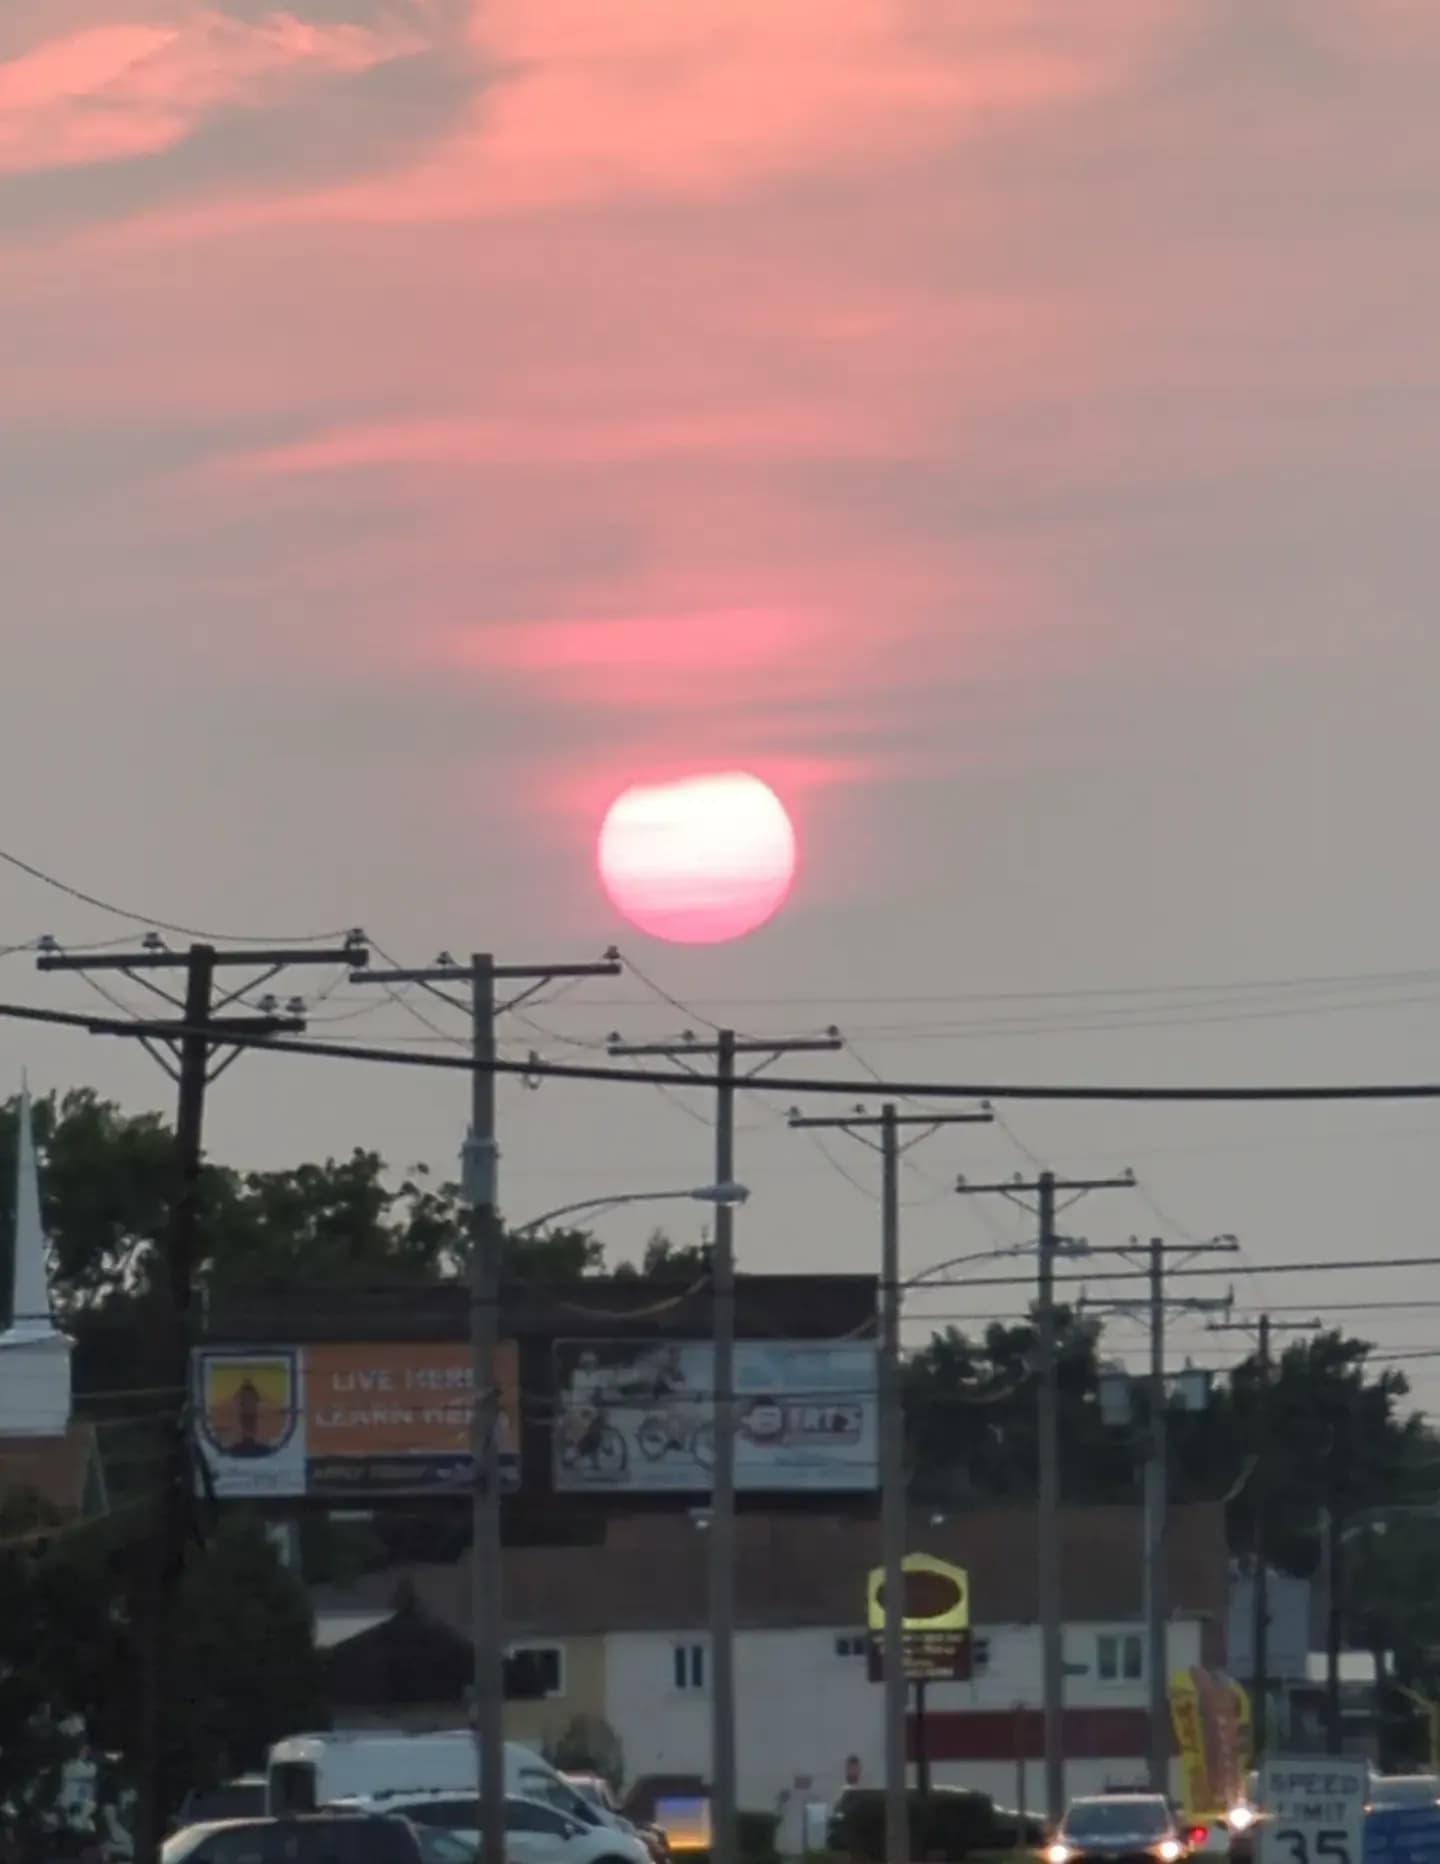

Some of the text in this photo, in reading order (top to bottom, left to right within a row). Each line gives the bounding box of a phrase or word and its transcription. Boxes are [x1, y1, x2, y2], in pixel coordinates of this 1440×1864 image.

[333, 1368, 394, 1391] LIVE
[1270, 1773, 1359, 1794] SPEED
[1277, 1801, 1346, 1822] LIMIT
[1275, 1830, 1350, 1864] 35
